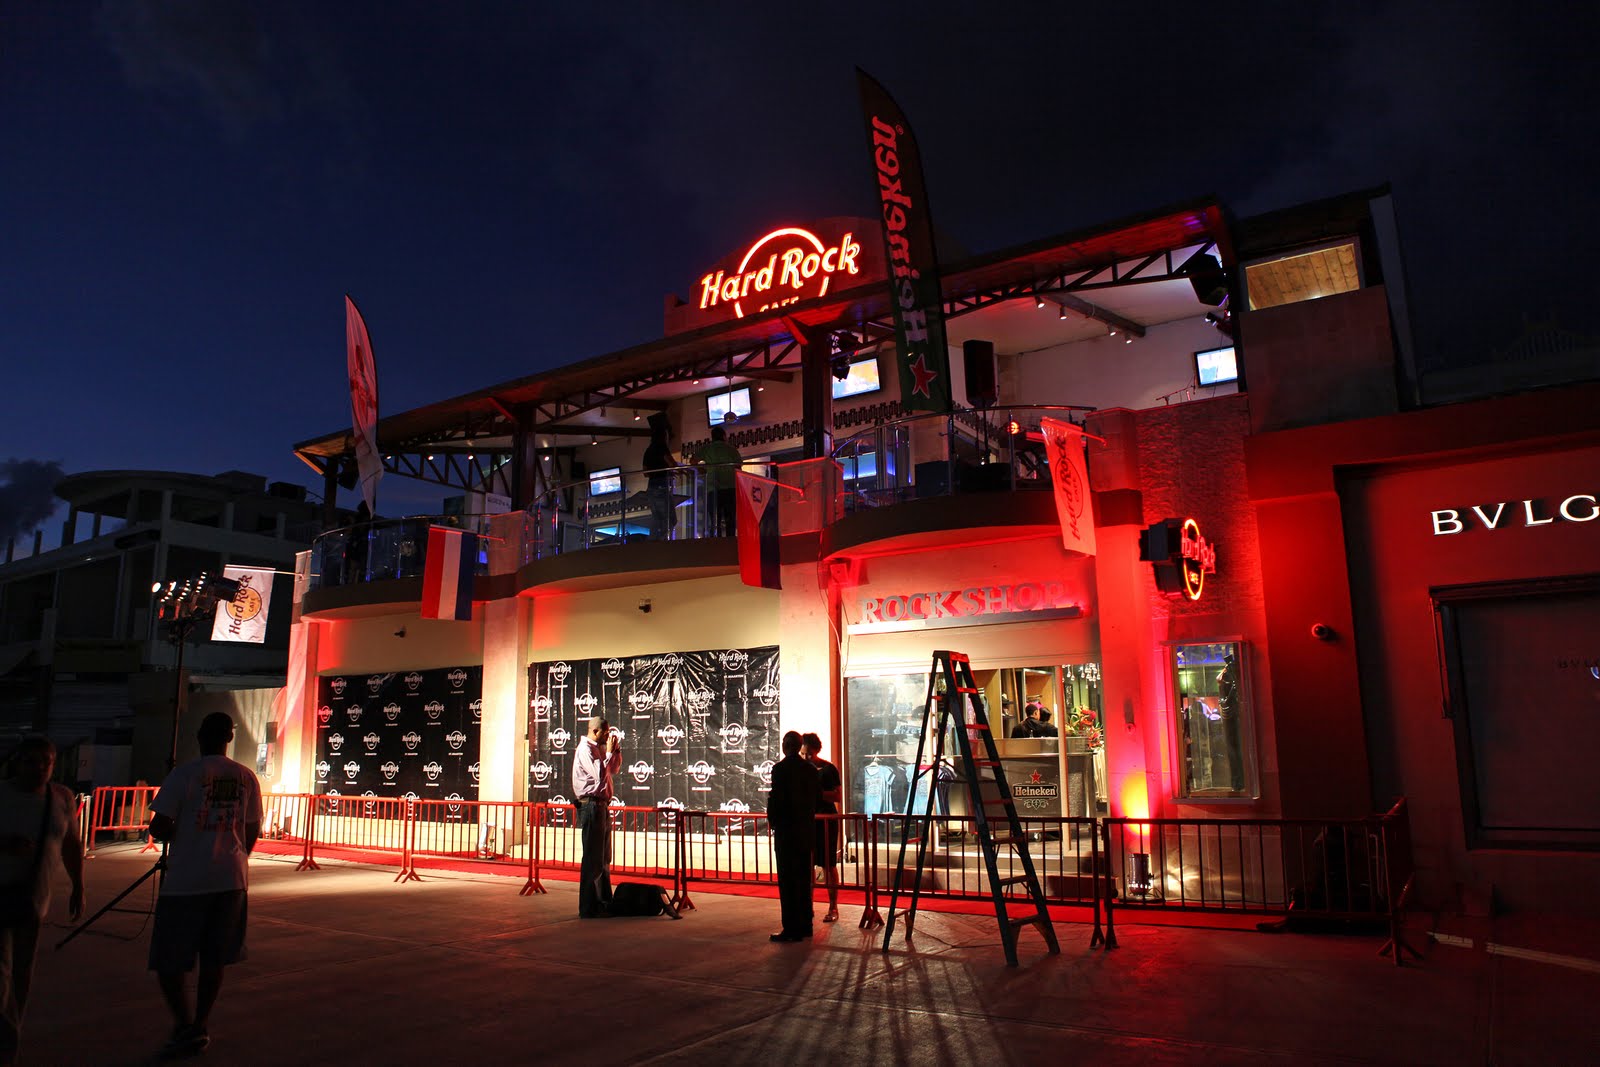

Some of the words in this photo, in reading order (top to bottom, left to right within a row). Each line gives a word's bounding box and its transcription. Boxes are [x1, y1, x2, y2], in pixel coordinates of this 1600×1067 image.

[872, 115, 928, 347] Heineken
[699, 252, 777, 309] Hard
[779, 231, 861, 290] Rock
[228, 603, 244, 635] Hard
[238, 575, 252, 604] Rock
[862, 590, 955, 622] ROCK
[961, 582, 1065, 616] SHOP
[1015, 786, 1056, 796] Heineken
